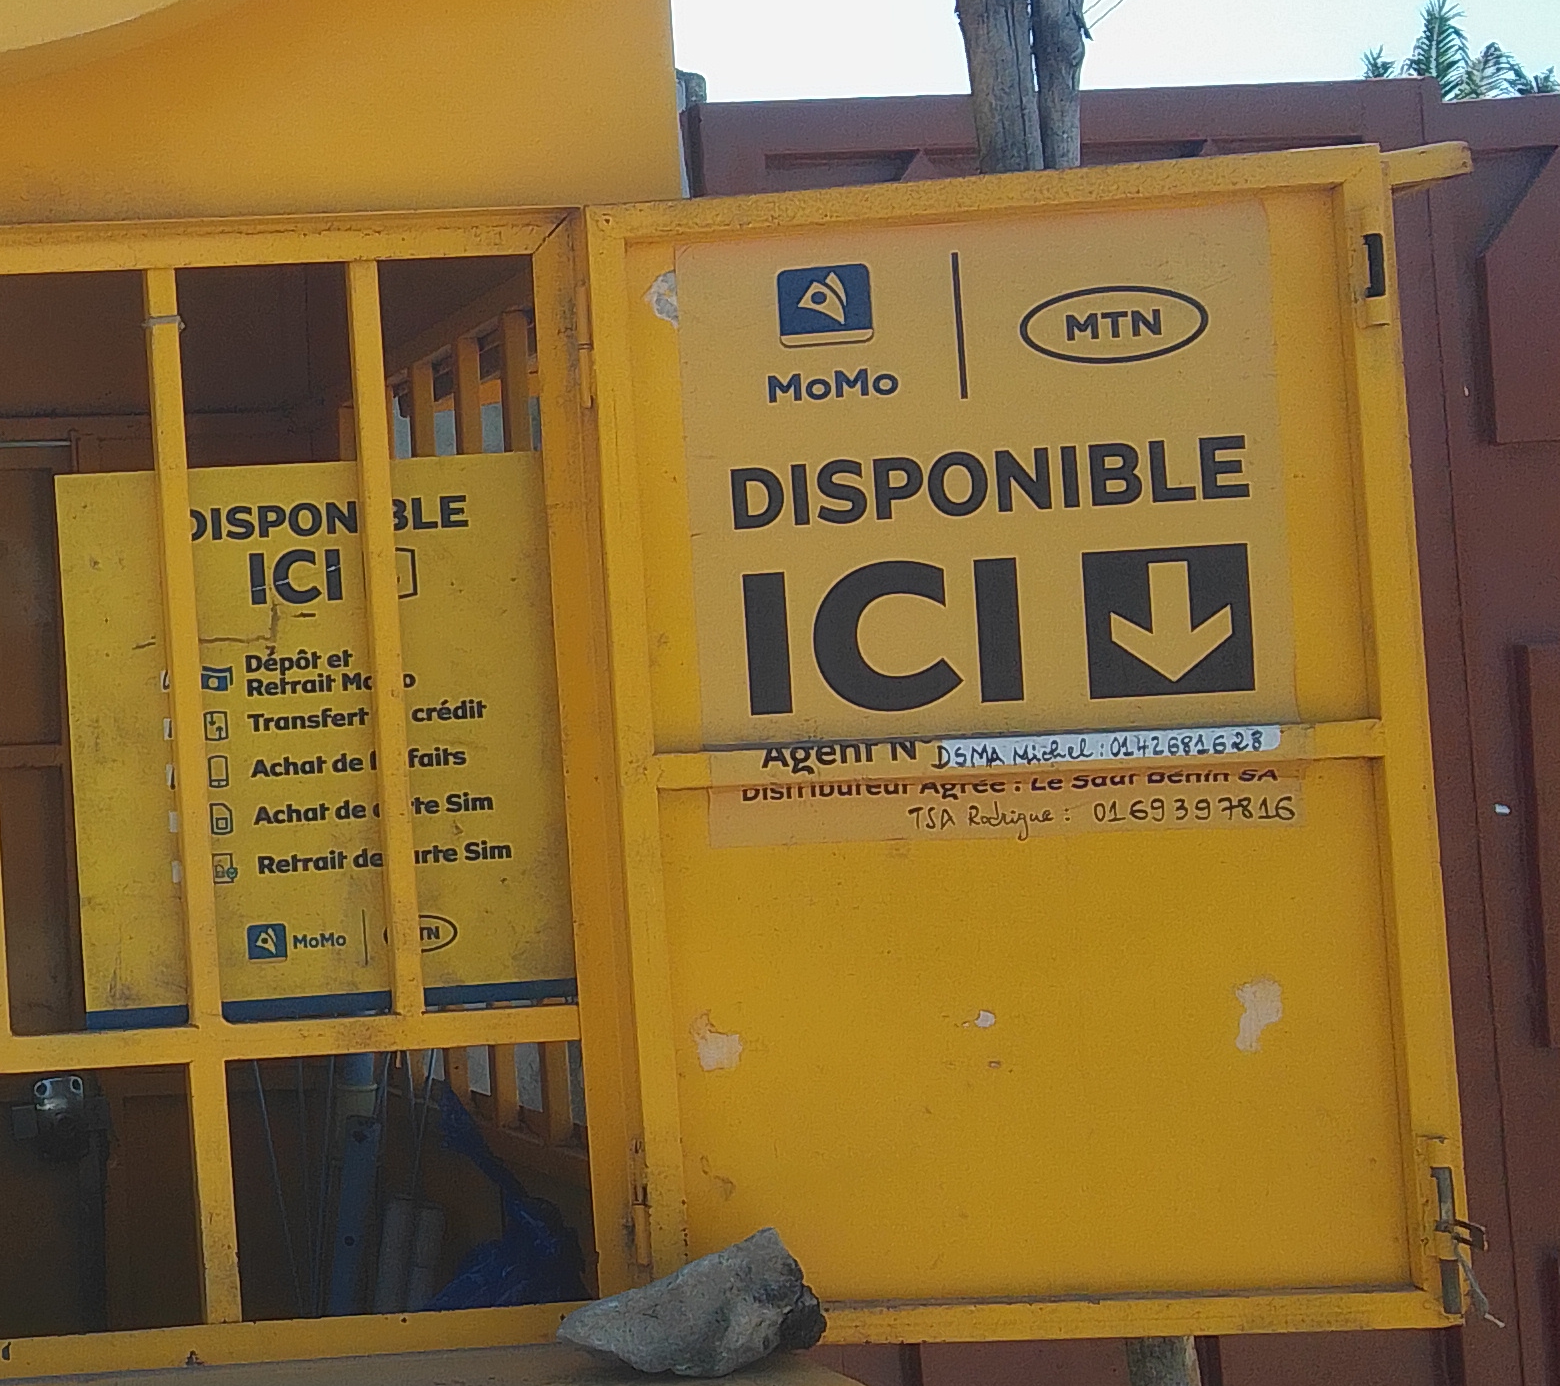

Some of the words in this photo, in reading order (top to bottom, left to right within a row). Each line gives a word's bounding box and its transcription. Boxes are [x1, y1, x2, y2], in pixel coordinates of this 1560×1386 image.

[1065, 308, 1164, 341] MTN
[767, 369, 900, 404] MoMo
[729, 435, 1251, 530] DISPONIBLE
[189, 495, 469, 542] DISPONBLE
[249, 548, 344, 605] ICI
[742, 557, 1025, 717] ICI
[245, 649, 322, 676] Dépôt
[327, 649, 353, 669] et
[246, 673, 336, 697] Retrait
[342, 672, 417, 692] Moo
[247, 707, 369, 733] Transfert
[411, 699, 487, 723] crédit
[250, 755, 327, 778] Achat
[332, 752, 364, 774] de
[1237, 768, 1279, 783] SA
[253, 803, 330, 826] Achat
[335, 800, 367, 821] de
[446, 792, 494, 813] Sim
[258, 849, 348, 875] Retrait
[353, 848, 383, 869] de
[464, 840, 513, 861] Sim
[293, 932, 347, 950] MoMo
